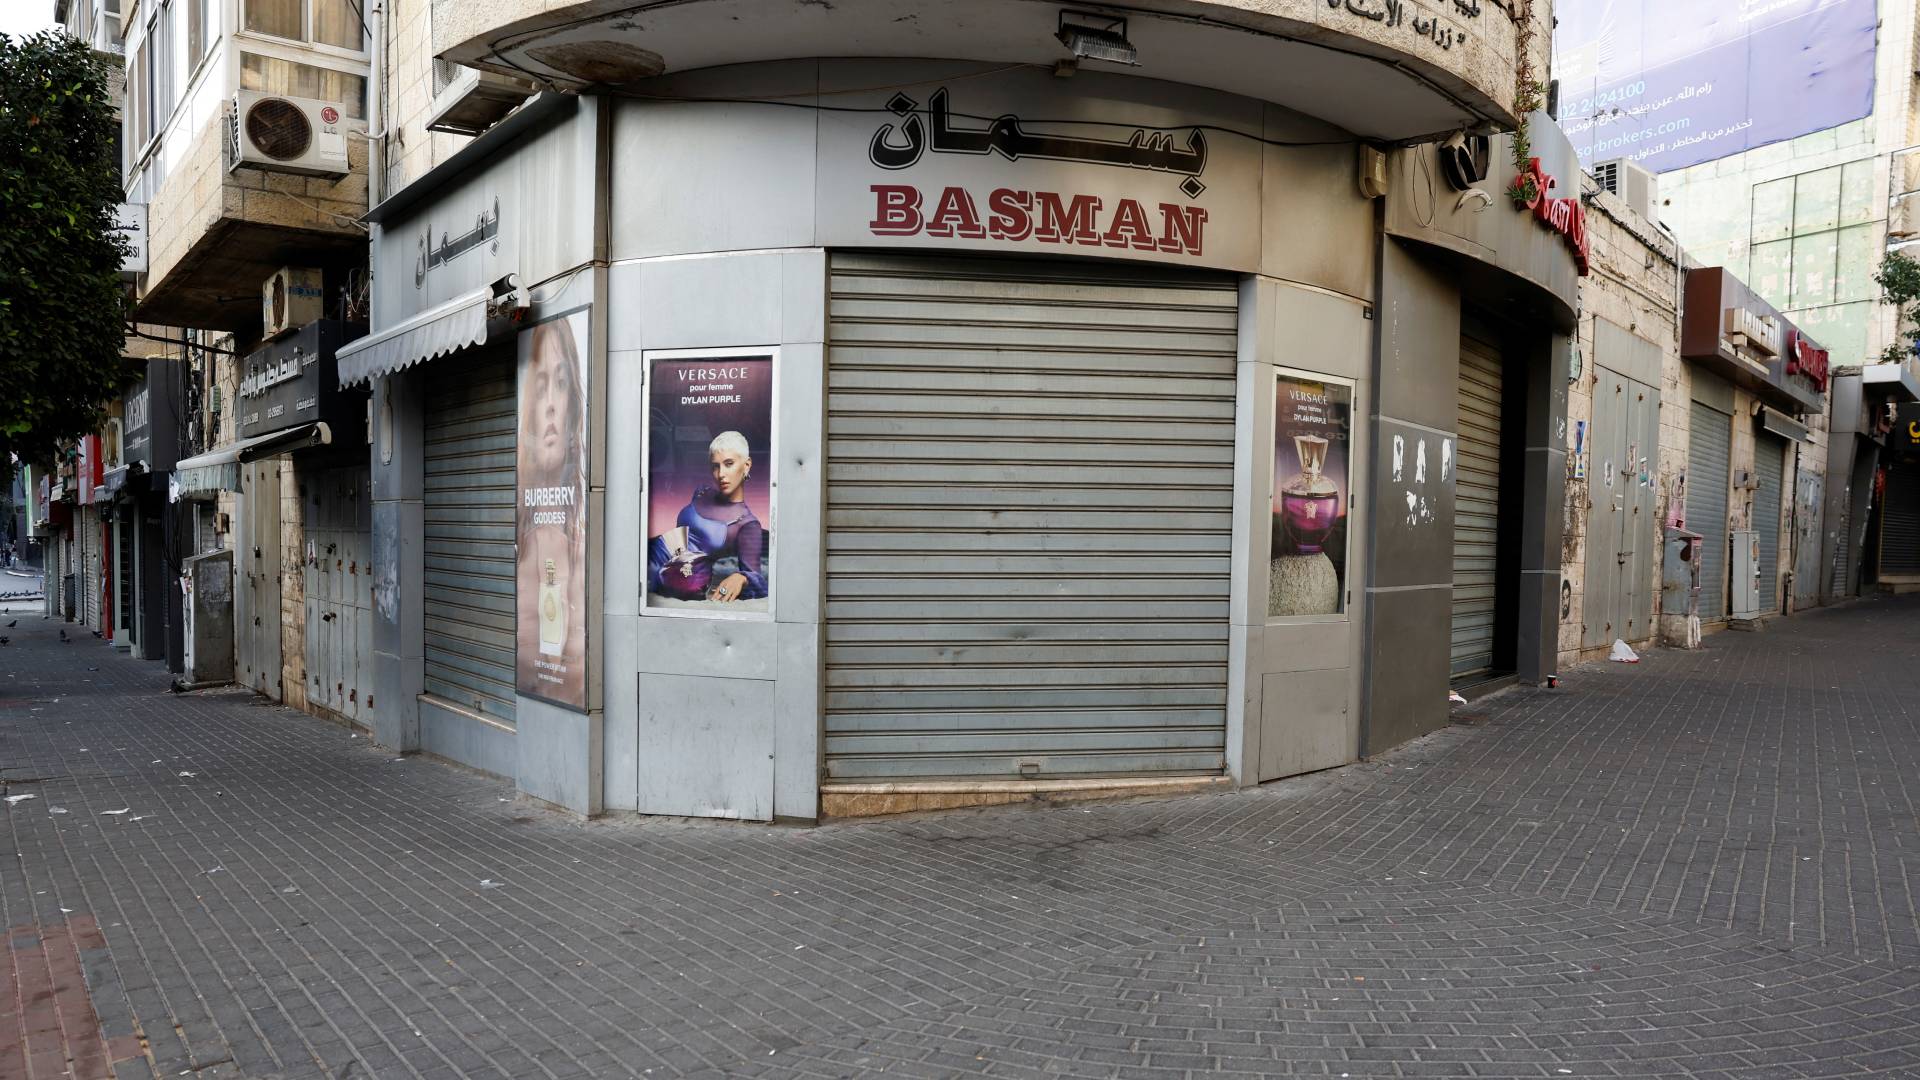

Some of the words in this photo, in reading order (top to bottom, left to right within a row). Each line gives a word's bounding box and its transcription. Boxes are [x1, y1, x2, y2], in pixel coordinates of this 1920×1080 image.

[869, 87, 1208, 199] بسمان
[1574, 116, 1691, 159] sorbrokers.com
[869, 184, 1209, 256] BASMAN
[415, 194, 500, 290] بسمان
[678, 367, 748, 381] VERSACE
[689, 384, 706, 392] pour
[708, 383, 733, 391] femme
[681, 396, 708, 404] DYLAN
[709, 395, 741, 403] PURPLE
[1289, 389, 1328, 405] VERSACE
[1293, 413, 1309, 423] DYLAN
[1309, 415, 1327, 424] PURPLE
[524, 486, 575, 507] BURBERRY
[533, 511, 566, 524] GODDESS
